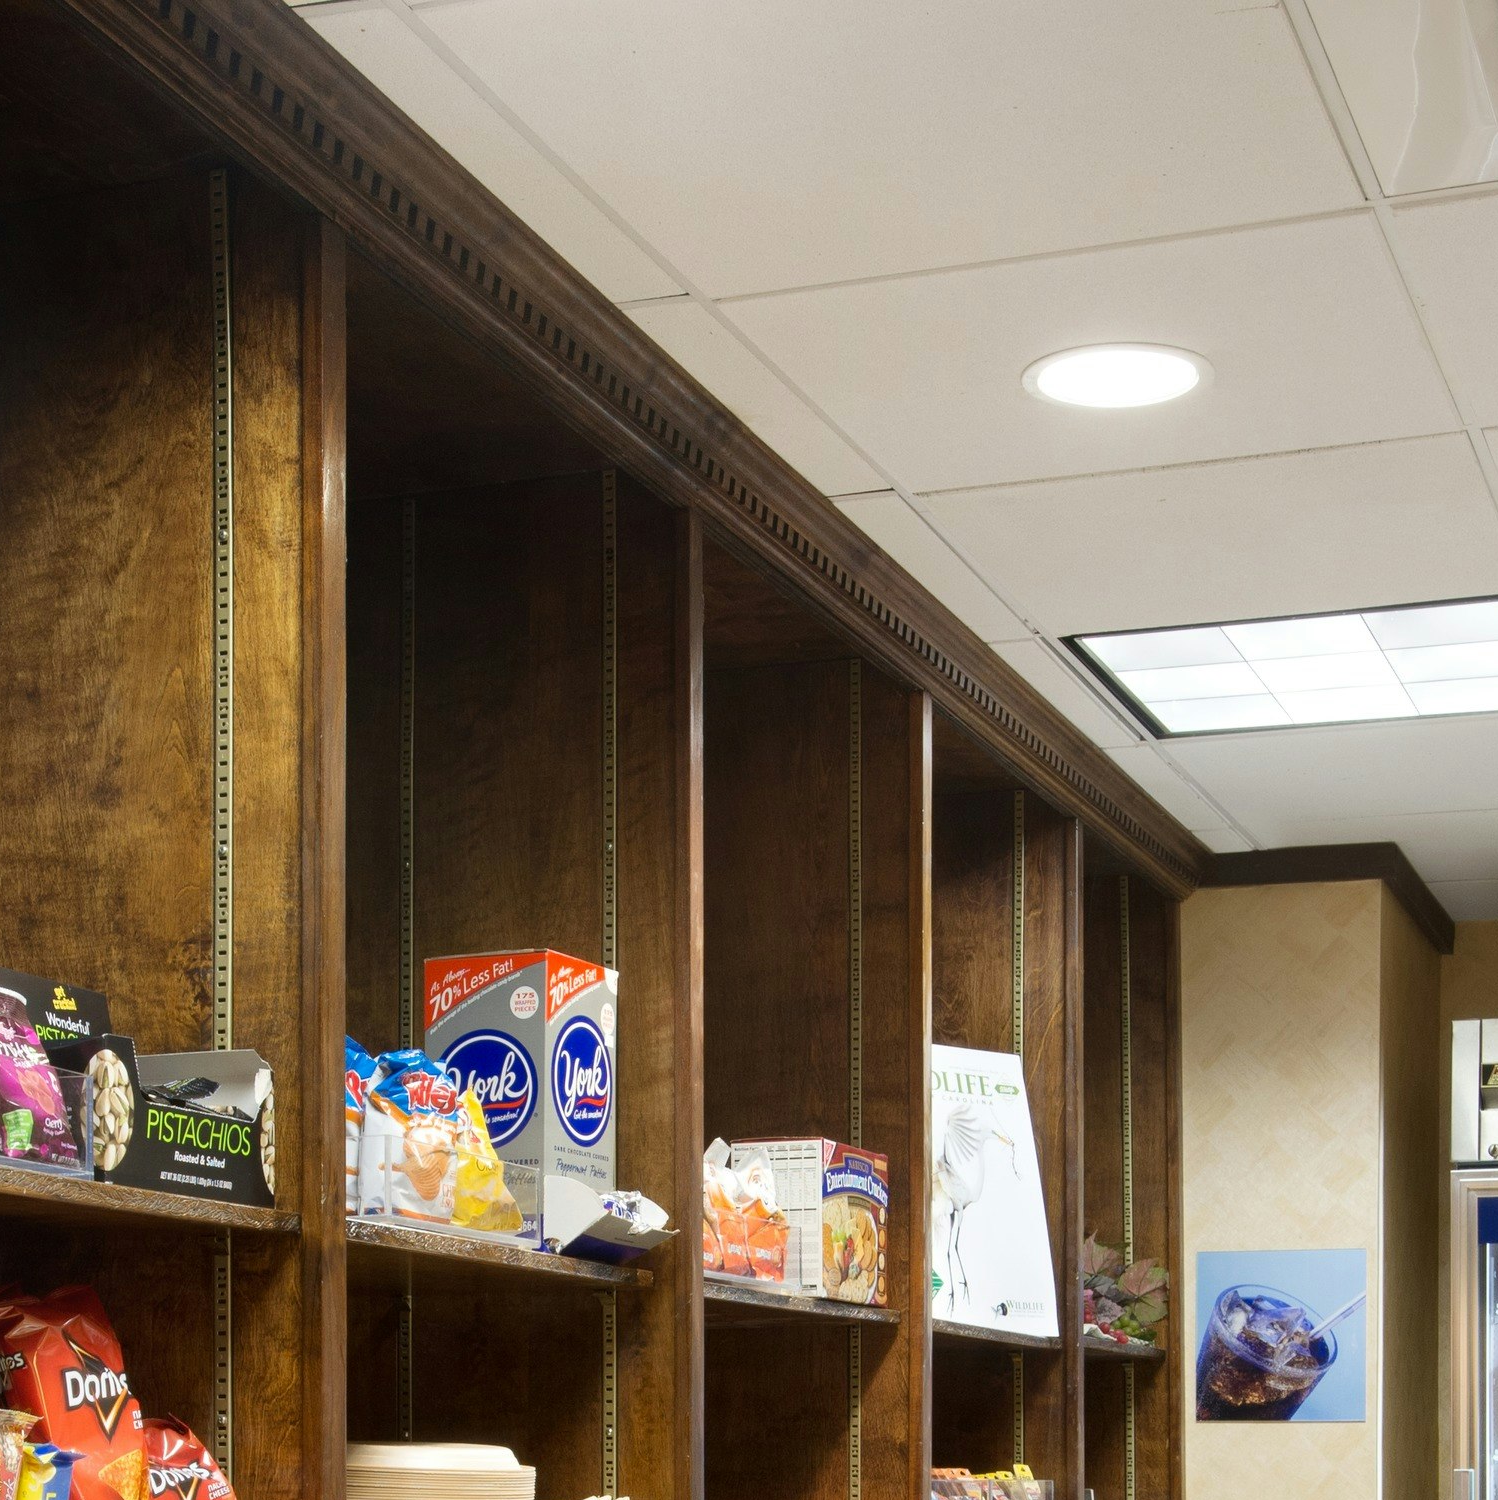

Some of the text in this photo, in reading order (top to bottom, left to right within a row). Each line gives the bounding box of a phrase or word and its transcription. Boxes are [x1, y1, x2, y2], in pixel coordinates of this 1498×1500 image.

[430, 958, 514, 1021] 70% Less Fat!
[569, 972, 584, 993] Less
[45, 1011, 90, 1036] Wonderful
[561, 1045, 610, 1118] York
[146, 1108, 251, 1156] PISTACHIOS
[174, 1150, 226, 1169] Roasted Salted
[825, 1171, 869, 1195] Entertainment
[208, 1486, 231, 1500] CHEESE
